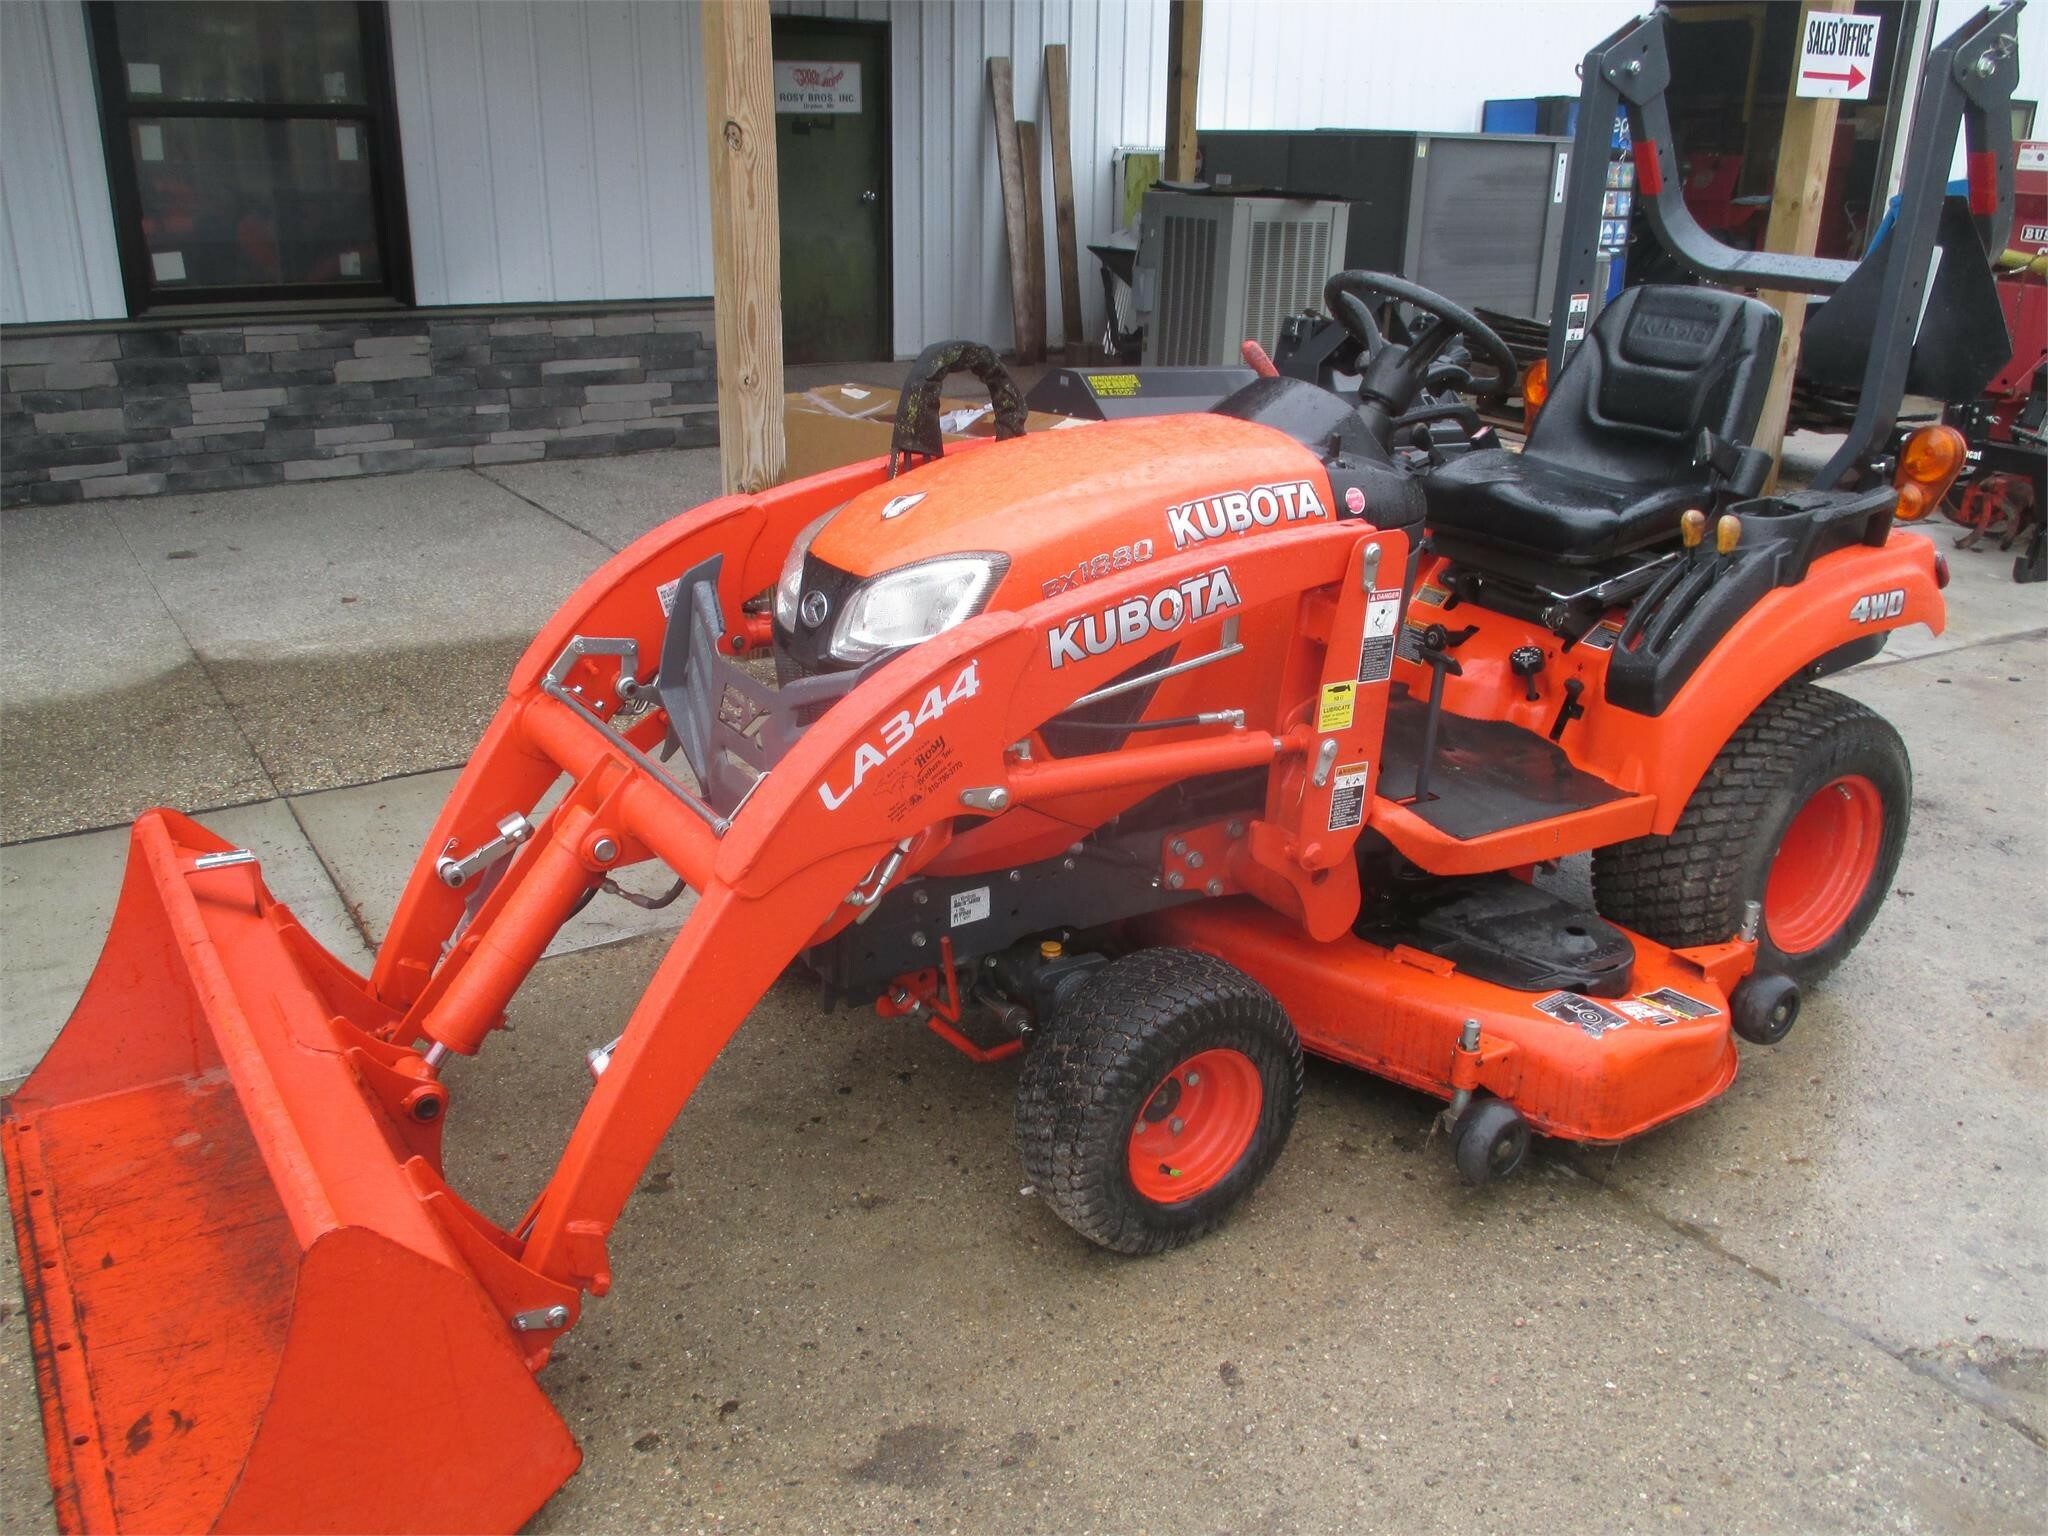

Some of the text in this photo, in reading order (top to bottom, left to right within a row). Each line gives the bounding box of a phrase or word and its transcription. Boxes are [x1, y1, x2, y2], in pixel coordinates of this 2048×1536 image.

[1806, 20, 1875, 57] SALES OFFICE
[779, 92, 804, 103] ROSY
[1167, 481, 1327, 549] KUBOTA
[1042, 538, 1154, 600] BX1880
[1376, 591, 1400, 601] DANGER
[1848, 589, 1905, 624] 4WD
[1047, 567, 1242, 671] KUBOTA
[1322, 703, 1351, 714] LUBRICATE
[818, 661, 980, 811] LA344
[914, 735, 945, 767] Rosy
